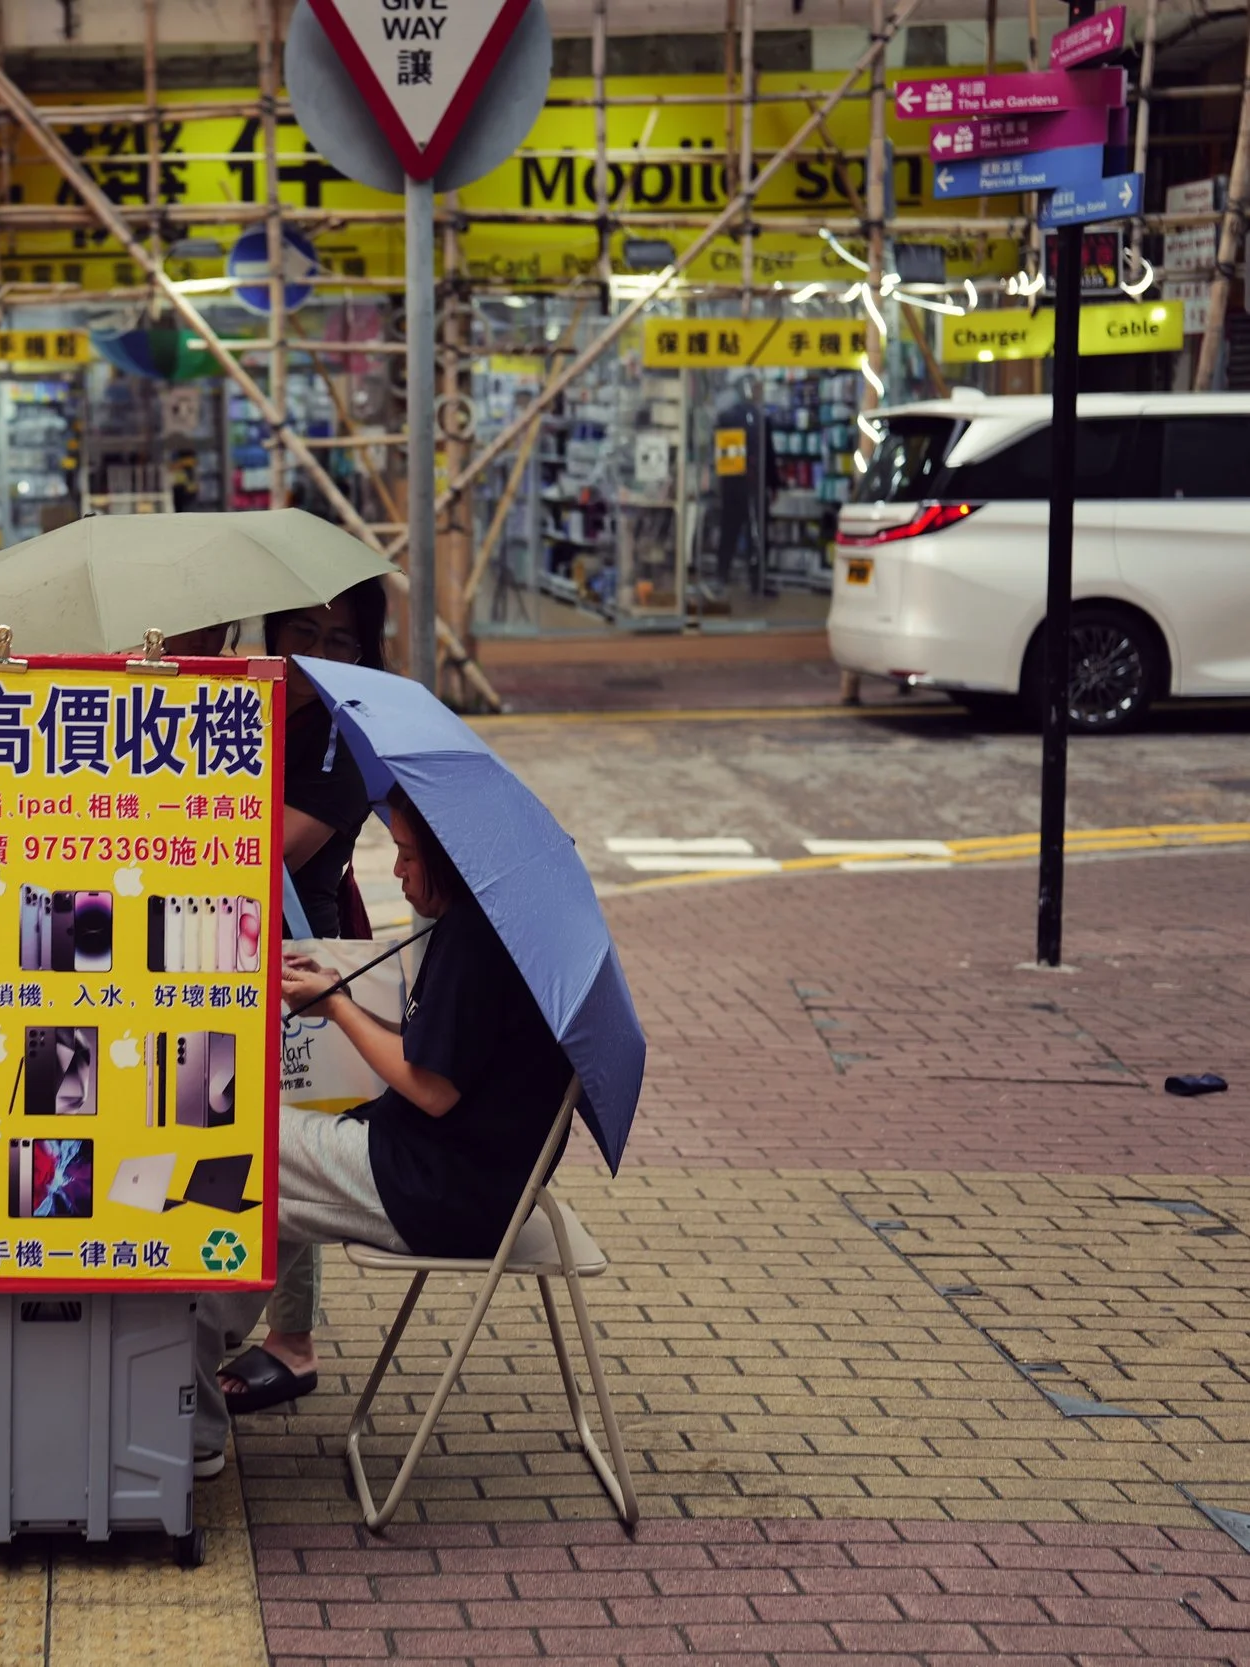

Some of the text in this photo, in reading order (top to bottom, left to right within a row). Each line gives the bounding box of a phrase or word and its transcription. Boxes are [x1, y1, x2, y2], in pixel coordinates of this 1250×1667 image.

[382, 16, 448, 40] WAY
[397, 48, 433, 86] 讓
[958, 94, 1059, 110] The Lee Gardens
[979, 173, 1047, 190] Percival Street
[953, 318, 1160, 347] Charger Cable
[24, 836, 263, 866] 97573369施小姐
